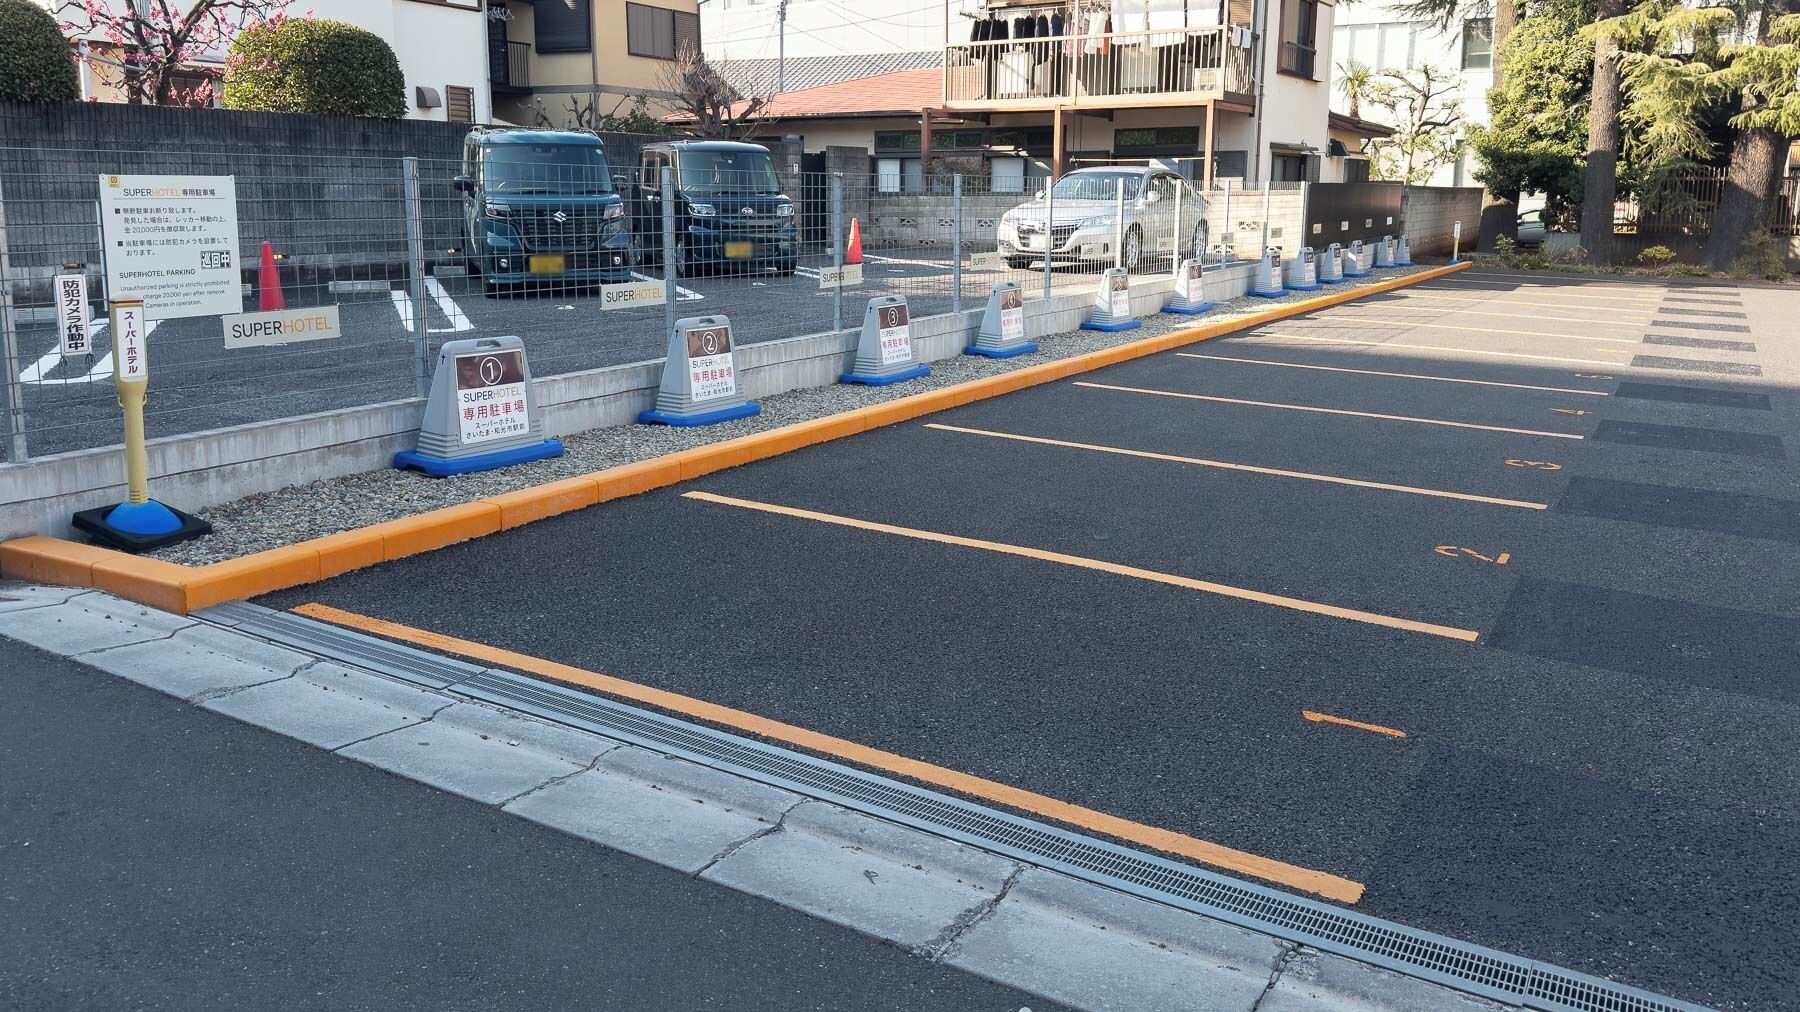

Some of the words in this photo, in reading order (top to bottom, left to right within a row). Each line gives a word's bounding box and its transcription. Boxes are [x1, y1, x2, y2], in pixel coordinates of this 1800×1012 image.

[182, 188, 216, 197] 専用駐車場
[201, 251, 230, 269] 巡回中
[119, 271, 164, 279] SUPERHOTEL
[166, 268, 196, 276] PARKING
[120, 284, 157, 292] Unauthorized
[606, 287, 663, 302] SUPERHOTEL
[63, 280, 84, 351] 防犯カメラ作動中
[231, 316, 333, 338] SUPERHOTEL
[124, 311, 138, 374] スーパーホテル
[463, 386, 521, 402] SUPERHOTEL
[463, 400, 525, 420] 専用駐車場
[475, 417, 516, 430] スーパーホテル
[1434, 545, 1511, 565] 2
